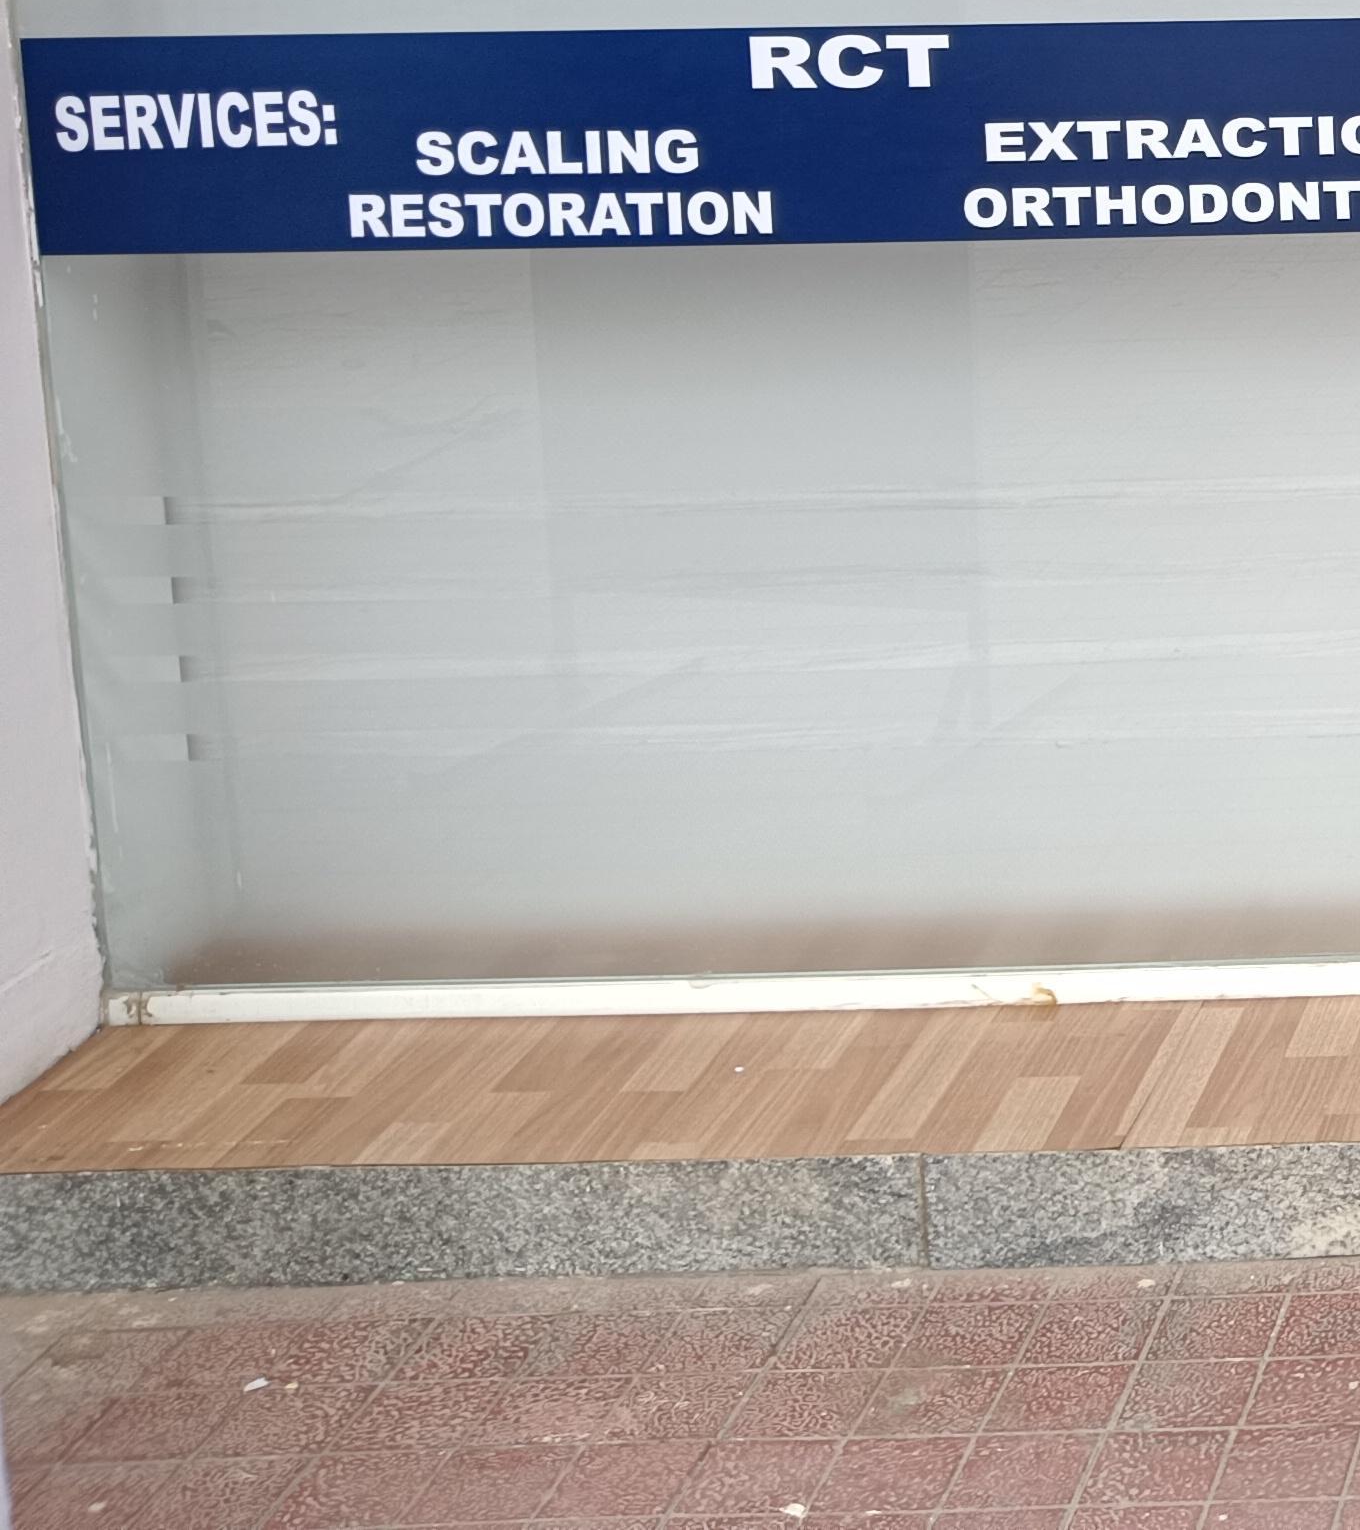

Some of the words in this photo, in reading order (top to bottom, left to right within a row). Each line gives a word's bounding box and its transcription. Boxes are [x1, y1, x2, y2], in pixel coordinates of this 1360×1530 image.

[748, 35, 950, 90] RCT
[55, 90, 338, 152] SERVICES:
[416, 129, 699, 176] SCALING
[348, 190, 773, 238] RESTORATION
